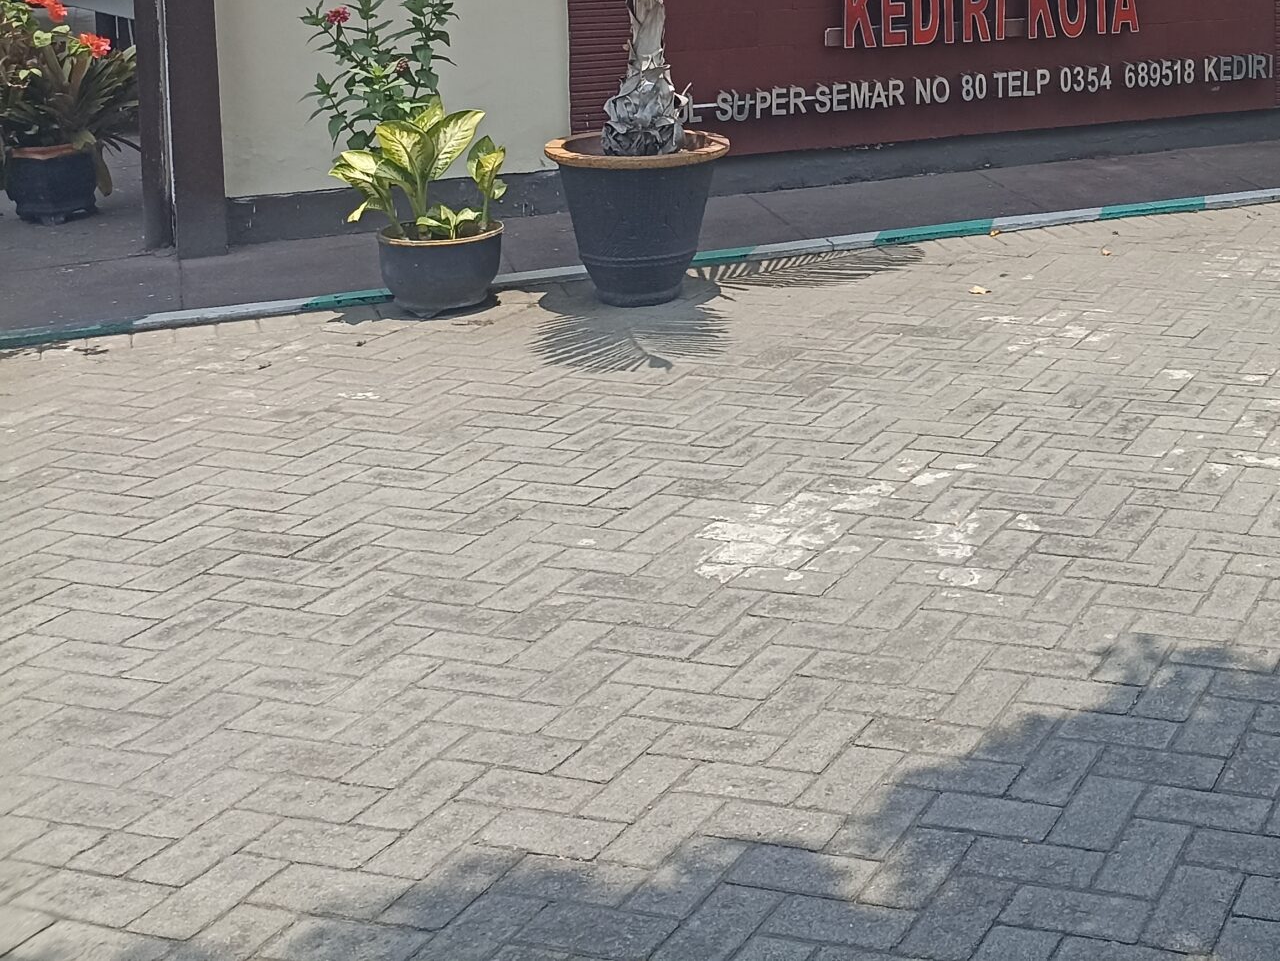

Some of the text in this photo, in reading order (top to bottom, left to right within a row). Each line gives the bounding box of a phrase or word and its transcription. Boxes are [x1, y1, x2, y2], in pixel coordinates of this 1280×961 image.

[715, 86, 807, 121] SUPER
[815, 80, 905, 113] SEMAR
[914, 76, 950, 105] NO
[961, 73, 987, 102] 80
[994, 68, 1051, 98] TELP
[1060, 65, 1112, 94] 0354
[1124, 58, 1195, 89] 689518
[1204, 54, 1274, 82] KEDIRI
